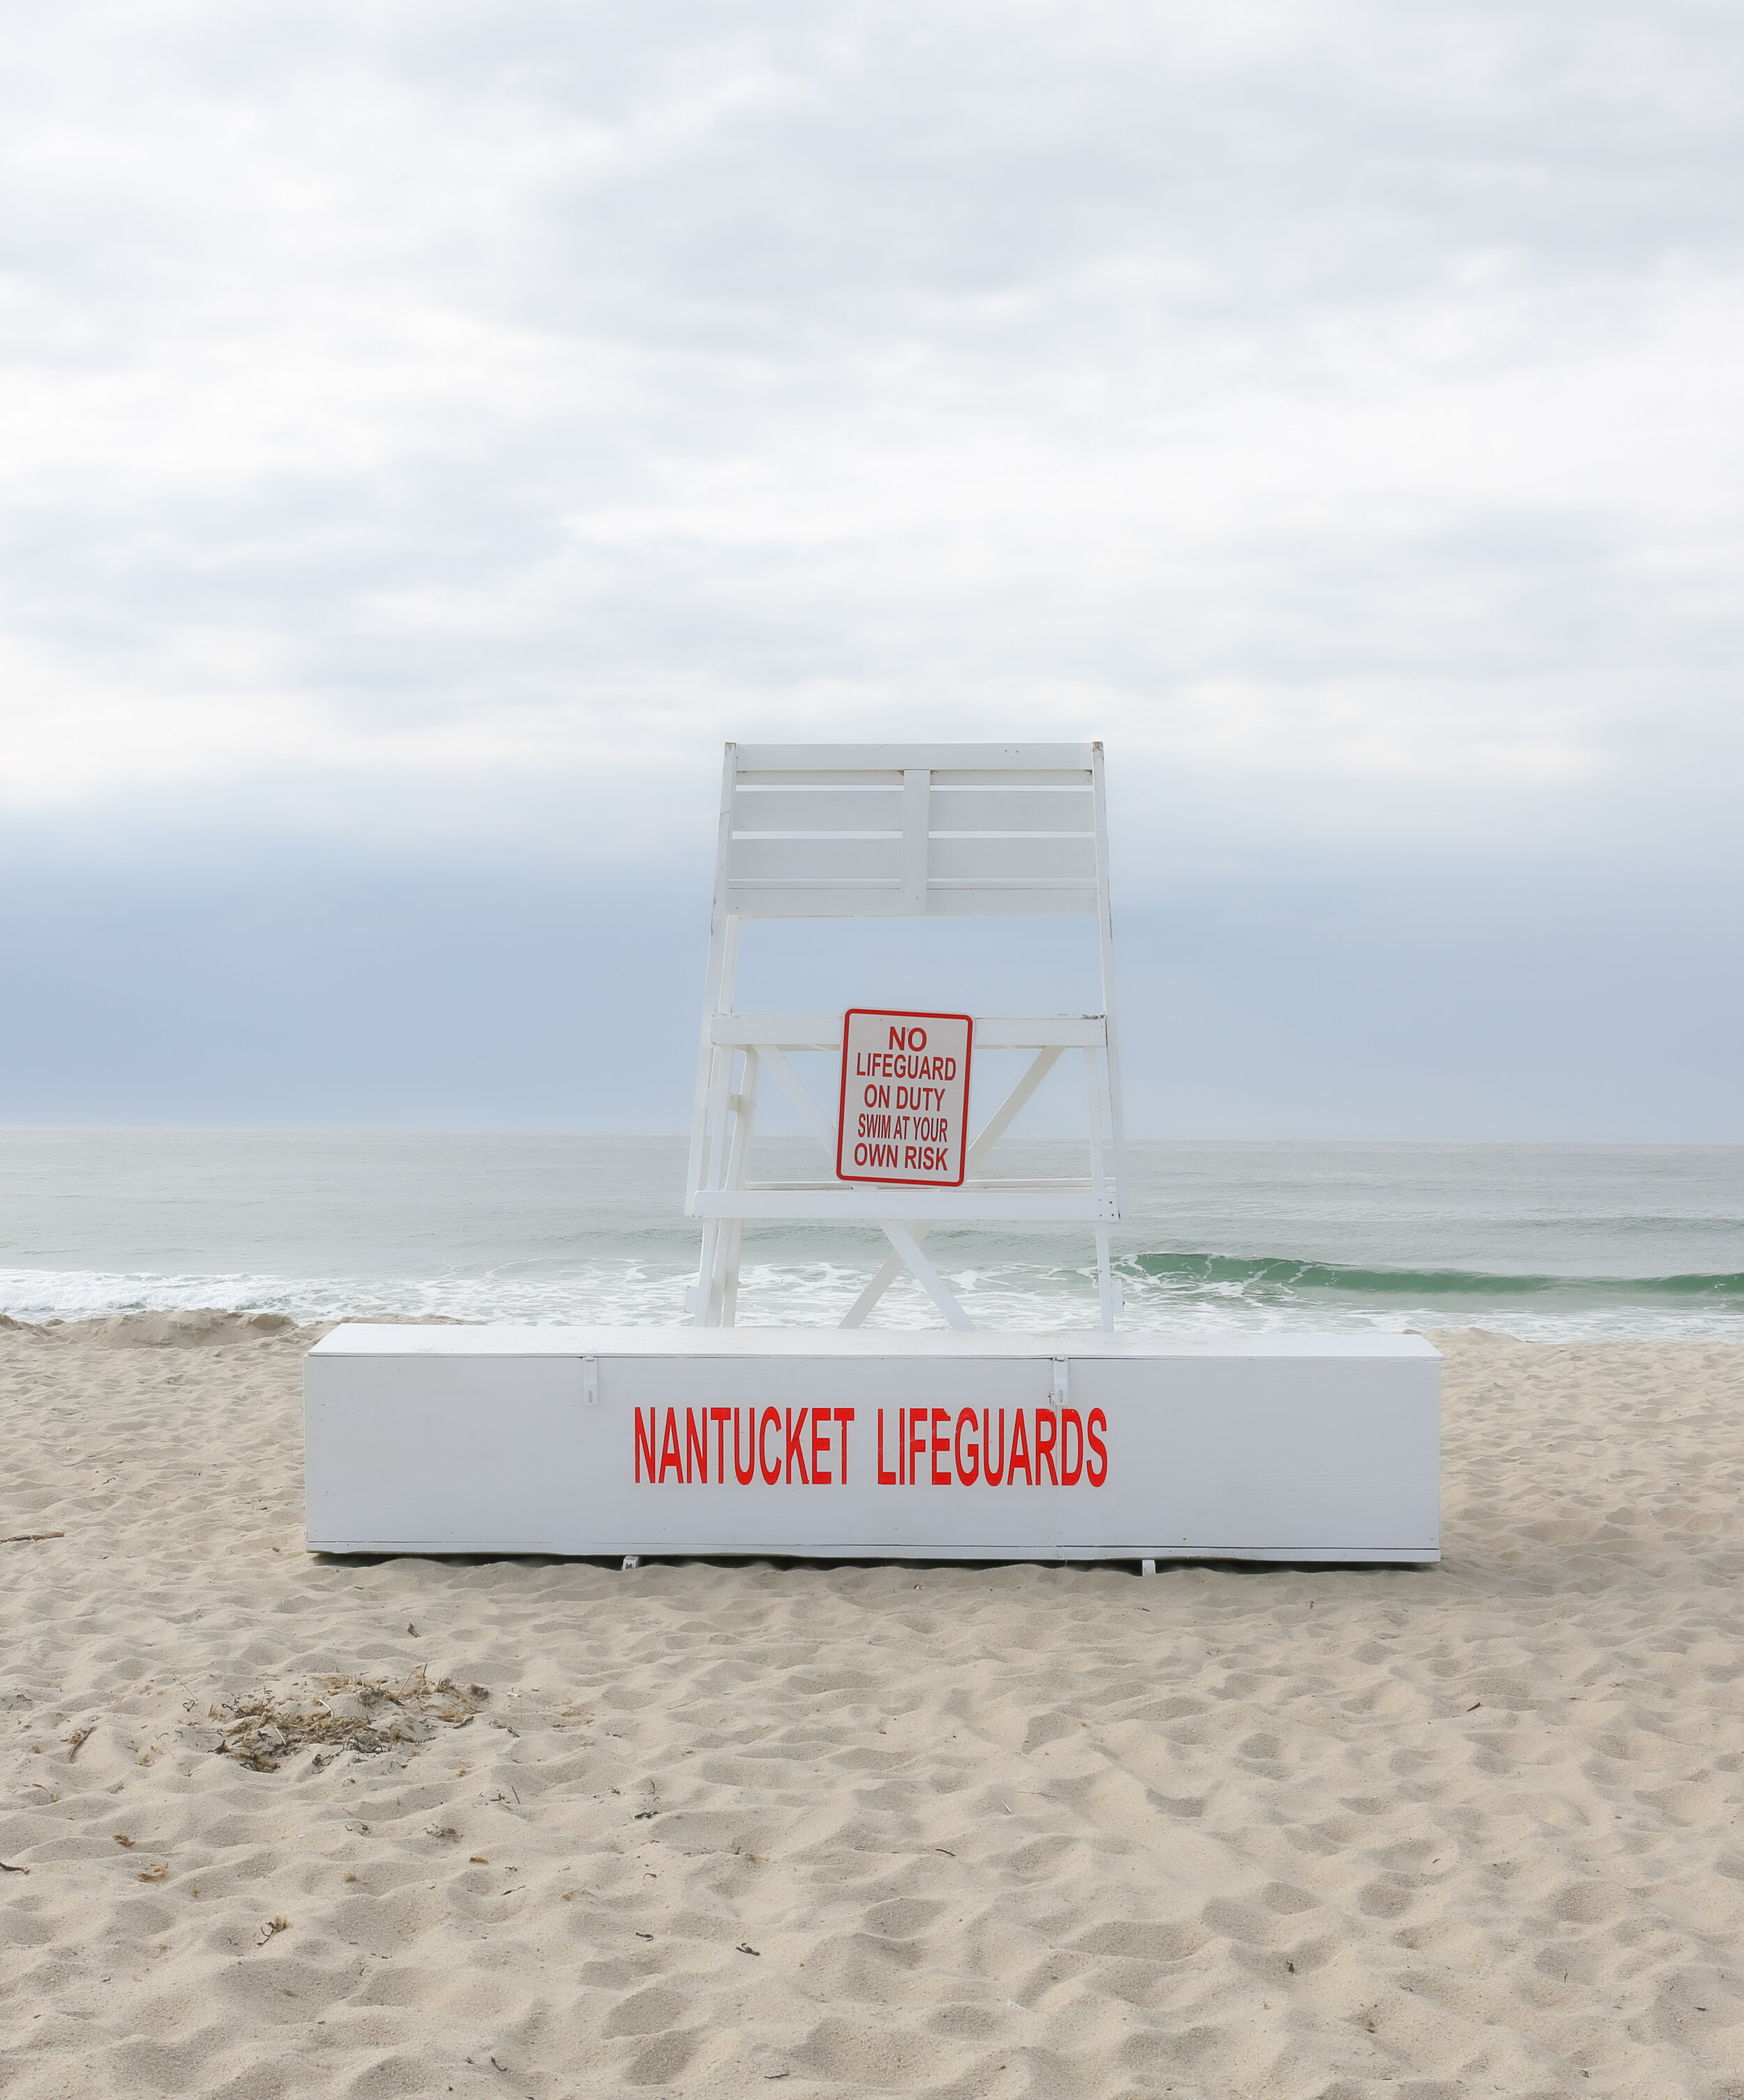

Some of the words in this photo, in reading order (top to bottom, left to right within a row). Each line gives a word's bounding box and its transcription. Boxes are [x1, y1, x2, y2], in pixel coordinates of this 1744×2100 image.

[889, 1026, 927, 1052] NO
[856, 1052, 956, 1081] LIFEGUARD
[864, 1084, 891, 1109] ON
[896, 1086, 946, 1112] DUTY
[857, 1113, 892, 1140] SWIM
[893, 1116, 910, 1140] AT
[912, 1117, 949, 1142] YOUR
[854, 1142, 899, 1168] OWN
[904, 1146, 949, 1171] RISK
[634, 1406, 855, 1486] NANTUCKET
[878, 1407, 1108, 1488] LIFEGUARDS
